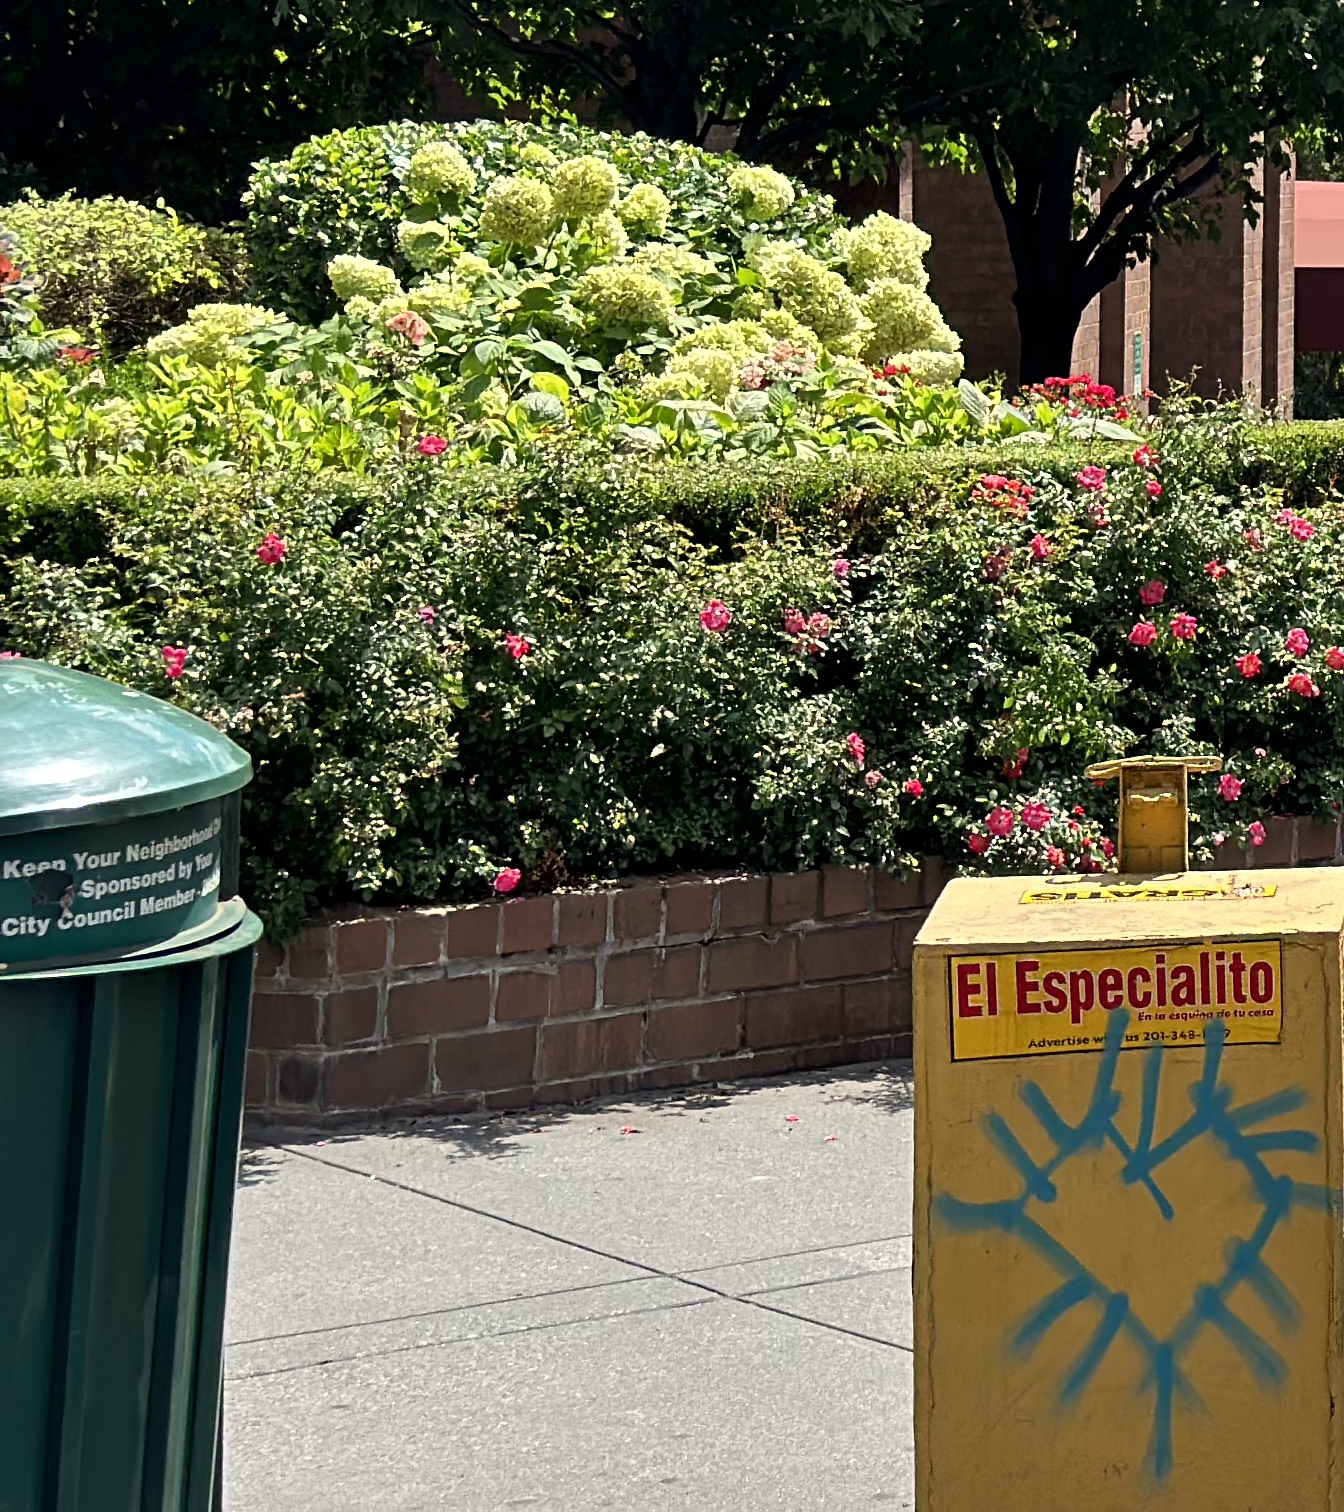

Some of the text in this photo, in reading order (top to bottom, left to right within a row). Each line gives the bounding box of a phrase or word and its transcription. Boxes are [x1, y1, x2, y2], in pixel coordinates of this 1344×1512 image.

[72, 851, 121, 871] Your
[126, 824, 213, 862] Neighborhood
[79, 864, 175, 900] Sponsored
[178, 860, 193, 879] by
[1, 888, 196, 937] City Council Member
[956, 950, 1275, 1026] El Especialito
[1138, 1011, 1152, 1021] En
[1234, 1009, 1245, 1018] tu
[1248, 1008, 1274, 1017] casa
[1028, 1035, 1090, 1049] Advertise
[1125, 1033, 1140, 1042] us
